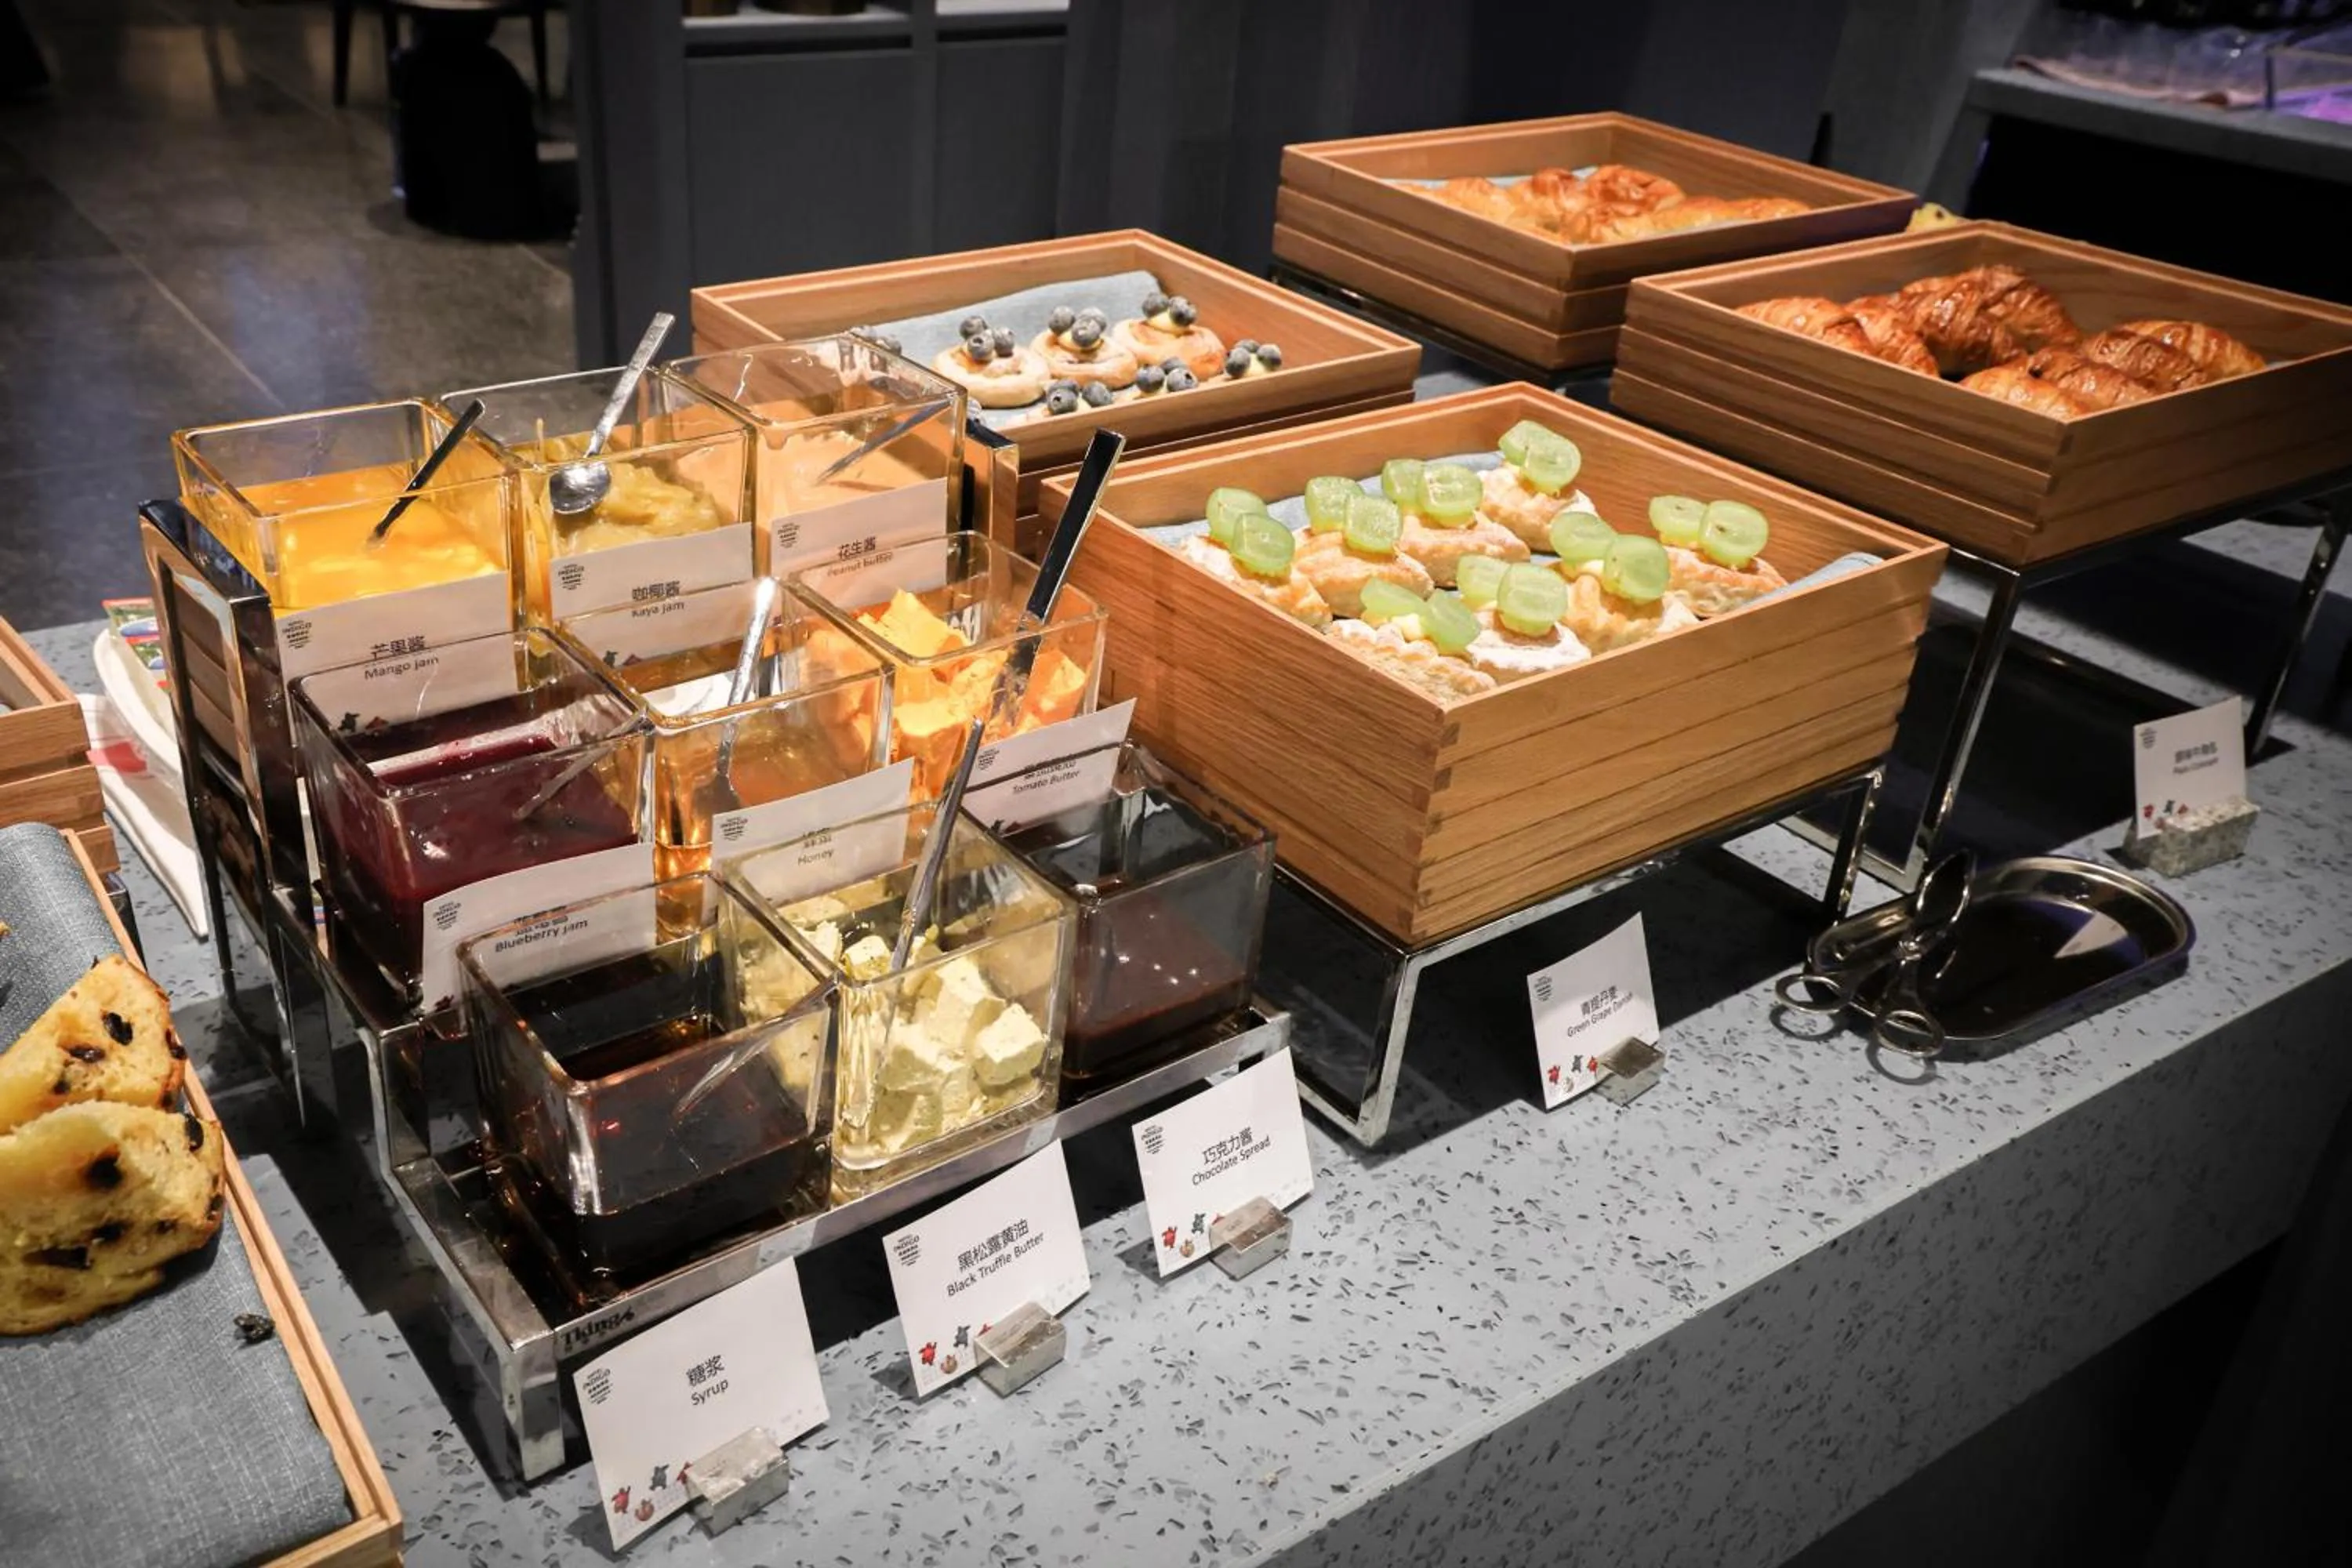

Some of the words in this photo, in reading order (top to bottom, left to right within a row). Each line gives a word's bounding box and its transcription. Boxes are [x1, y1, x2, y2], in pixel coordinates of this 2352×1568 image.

[837, 535, 876, 561] 花生酱
[660, 601, 684, 615] jam
[370, 635, 425, 660] 芒果酱
[364, 662, 412, 681] Mango
[797, 848, 835, 866] Honey
[495, 924, 560, 953] Blueberry
[561, 918, 589, 938] jam
[1566, 1020, 1591, 1037] Green
[1191, 1154, 1239, 1186] Chocolate
[1239, 1134, 1271, 1162] Spread
[1202, 1127, 1253, 1166] 巧克力酱
[957, 1217, 1029, 1272] 黑松露黄油
[946, 1272, 978, 1296] Black
[978, 1253, 1013, 1279] Truffle
[1014, 1232, 1045, 1258] Butter
[686, 1354, 725, 1386] 糖浆
[691, 1378, 730, 1406] Syrup
